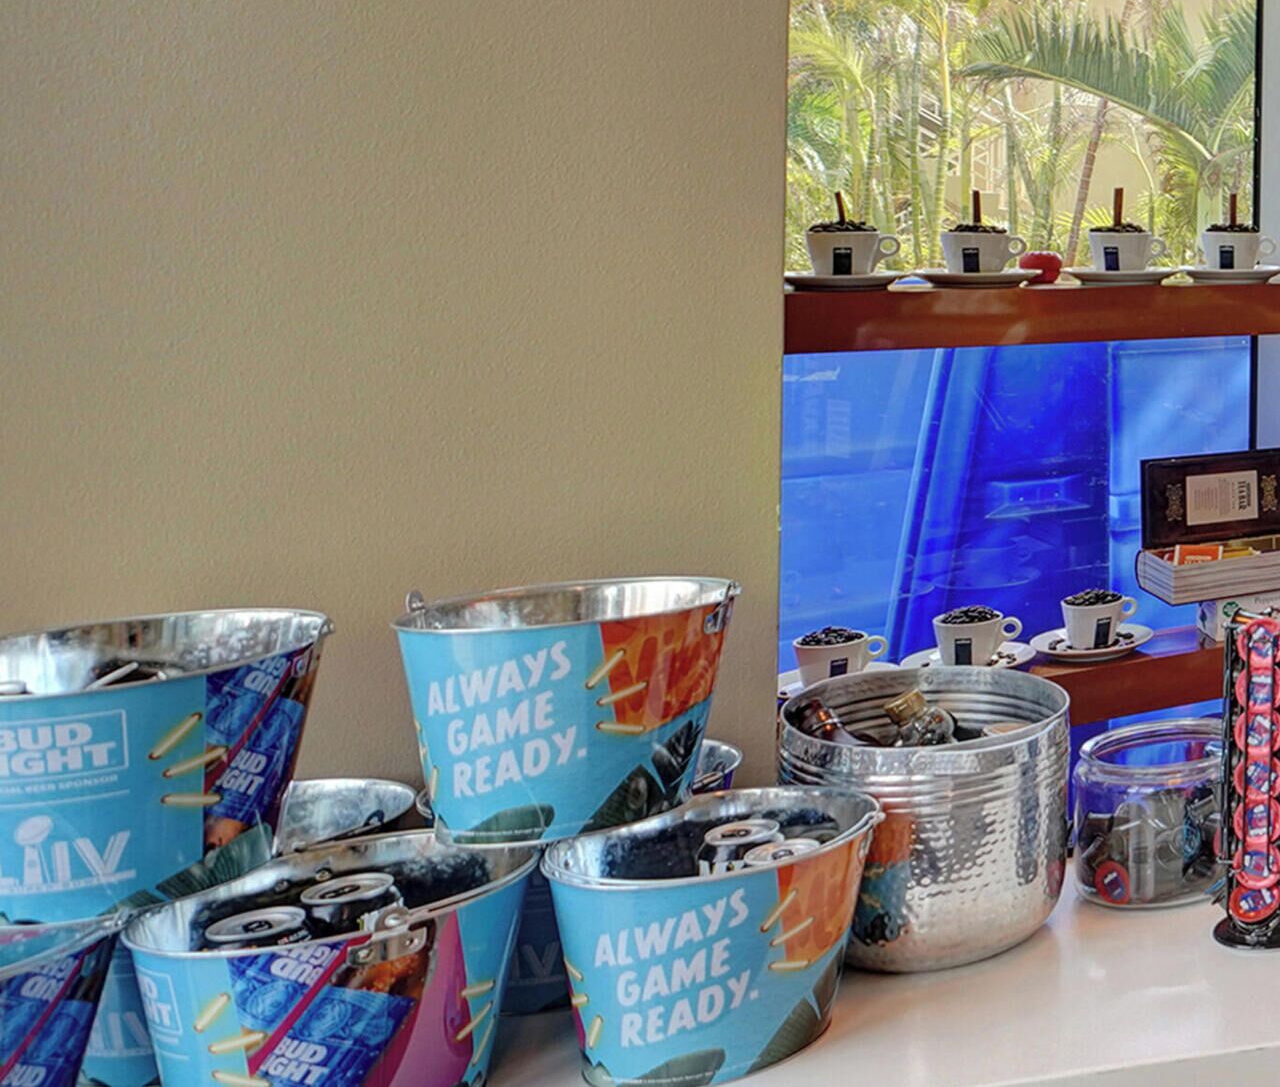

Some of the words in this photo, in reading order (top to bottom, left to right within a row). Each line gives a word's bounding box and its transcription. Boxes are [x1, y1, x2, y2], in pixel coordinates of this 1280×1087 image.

[428, 640, 572, 717] ALWAYS
[446, 691, 556, 756] GAME
[0, 742, 117, 778] IGHT
[215, 768, 265, 796] IGHT
[452, 725, 587, 799] READY.
[593, 887, 749, 969] ALWAYS
[615, 939, 732, 1005] GAME
[619, 969, 760, 1049] READY.
[260, 1054, 331, 1087] IGHT
